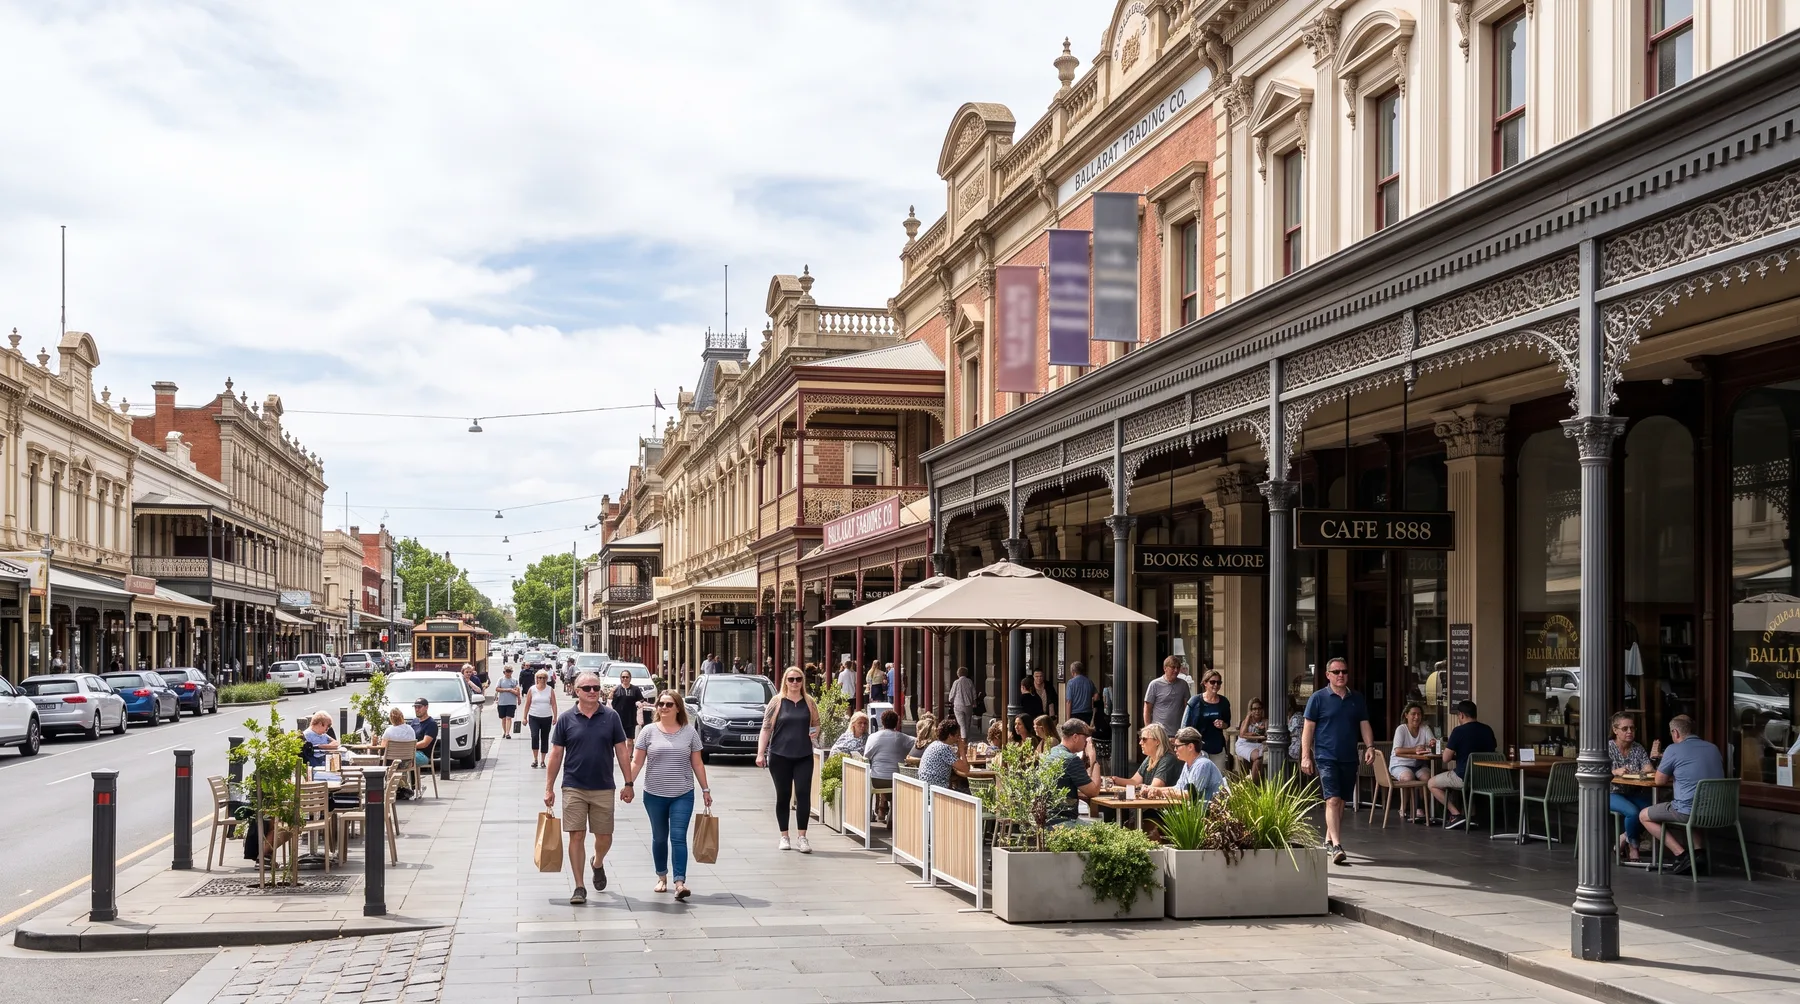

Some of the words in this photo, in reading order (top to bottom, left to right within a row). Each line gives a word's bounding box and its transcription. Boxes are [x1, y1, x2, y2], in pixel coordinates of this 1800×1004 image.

[1075, 141, 1119, 191] BALLARAT
[1123, 103, 1165, 152] TRADING
[1169, 88, 1187, 114] CO.
[1320, 519, 1379, 539] CAFE
[1385, 521, 1432, 540] 1888
[1142, 552, 1199, 567] BOOKS
[1202, 555, 1214, 567] &
[1217, 553, 1265, 568] MORE
